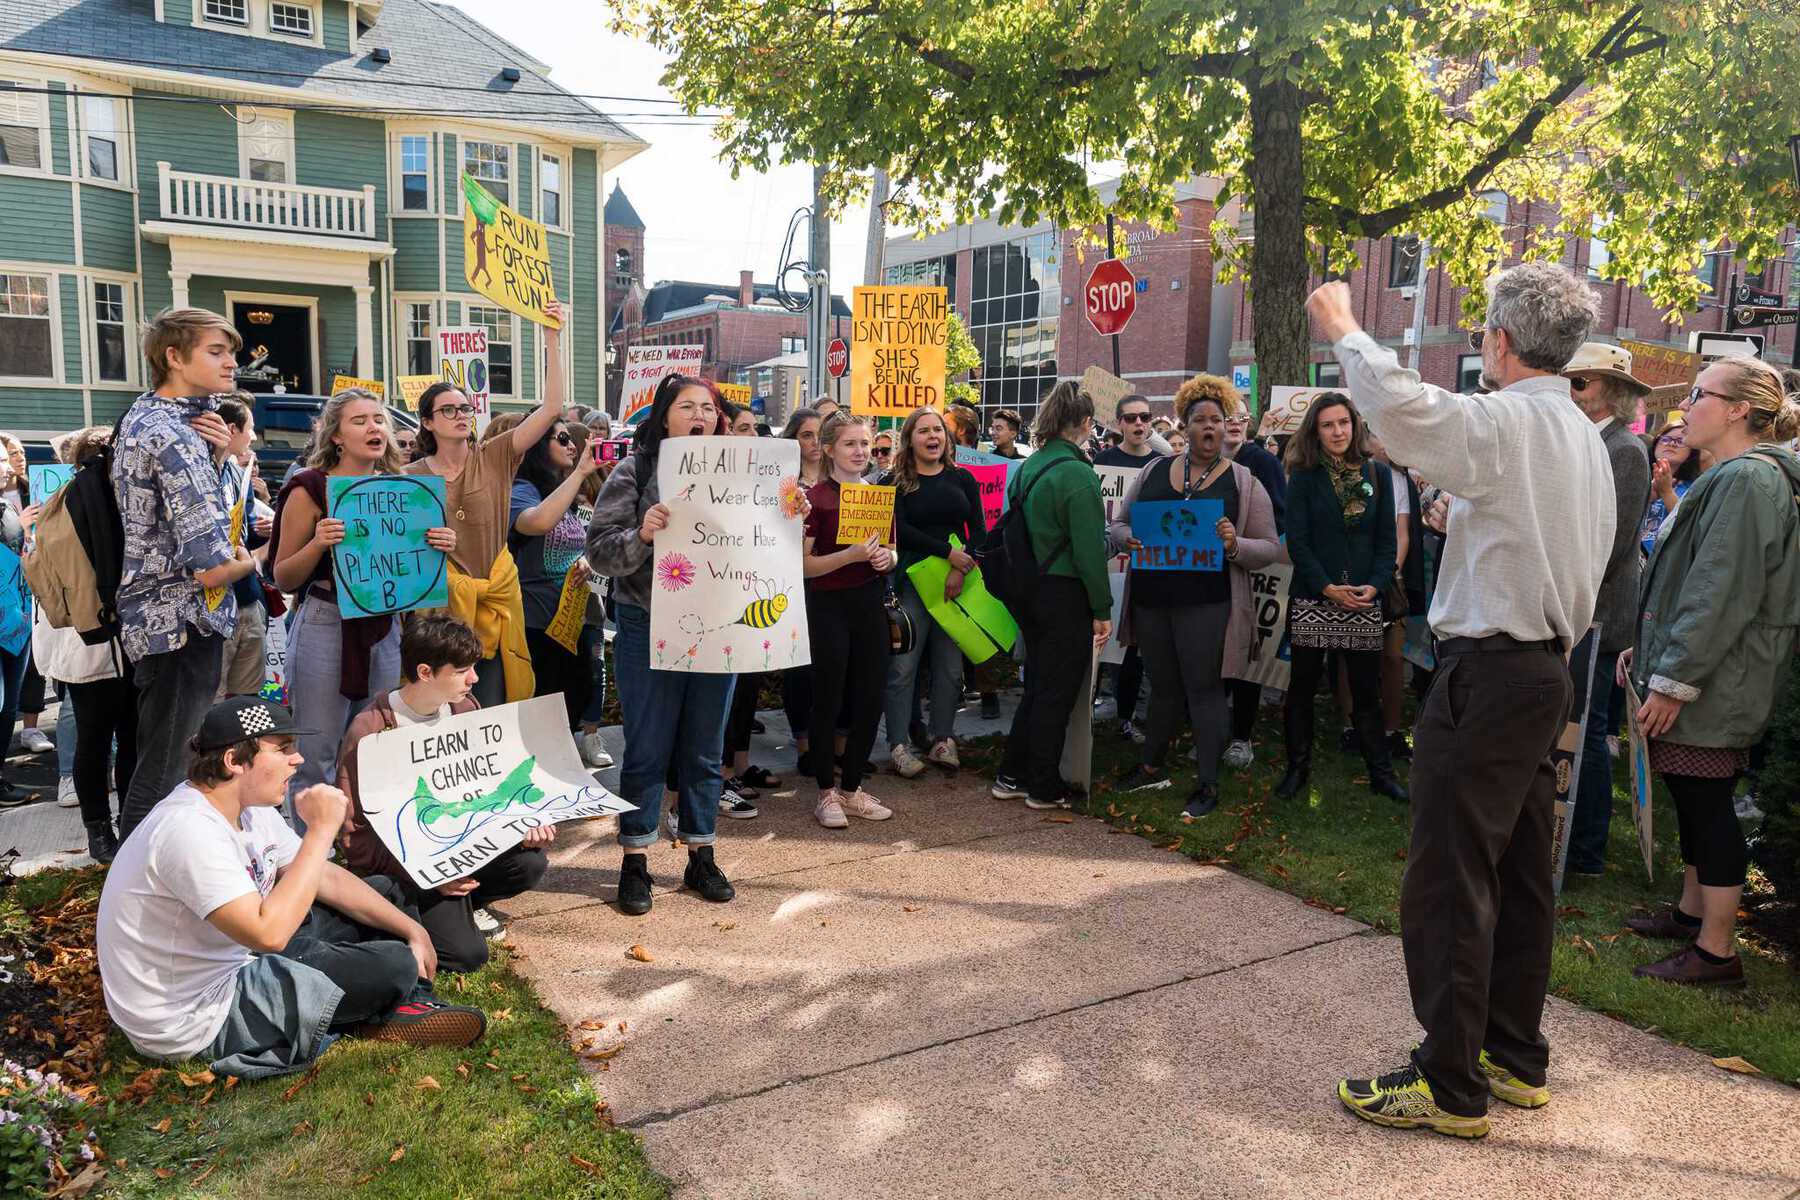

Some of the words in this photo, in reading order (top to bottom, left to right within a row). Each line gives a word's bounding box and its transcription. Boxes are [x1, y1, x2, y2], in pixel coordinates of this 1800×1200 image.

[501, 211, 538, 251] RUN
[495, 234, 551, 288] FOREST
[859, 292, 897, 319] THE
[900, 293, 947, 320] EARTH
[1089, 280, 1132, 313] STOP
[440, 329, 486, 354] THERE'S
[897, 321, 946, 345] DYING
[629, 349, 640, 363] WE
[641, 350, 663, 361] NEED
[828, 352, 846, 367] STOP
[627, 369, 638, 380] TO
[640, 365, 665, 380] FIGHT
[875, 368, 921, 385] BEING
[1234, 372, 1250, 388] Be
[868, 384, 937, 408] KILLED
[679, 446, 709, 477] Not
[713, 447, 737, 474] All
[747, 447, 782, 478] Hero's
[352, 491, 409, 515] THERE
[709, 484, 749, 507] Wear
[753, 484, 780, 508] Capes
[841, 488, 895, 506] CLIMATE
[353, 518, 369, 537] IS
[381, 517, 406, 536] NO
[841, 509, 892, 522] EMERGENCY
[692, 521, 744, 547] Some
[753, 524, 777, 548] Have
[838, 525, 860, 538] ACT
[345, 549, 428, 584] PLANET
[1136, 545, 1187, 567] HELP
[1191, 544, 1217, 568] ME
[707, 560, 759, 592] Wings
[385, 580, 397, 609] B
[410, 729, 469, 764] LEARN
[480, 724, 503, 745] TO
[431, 753, 502, 791] CHANGE
[462, 788, 484, 803] or
[418, 836, 499, 885] LEARN
[501, 816, 542, 835] TO
